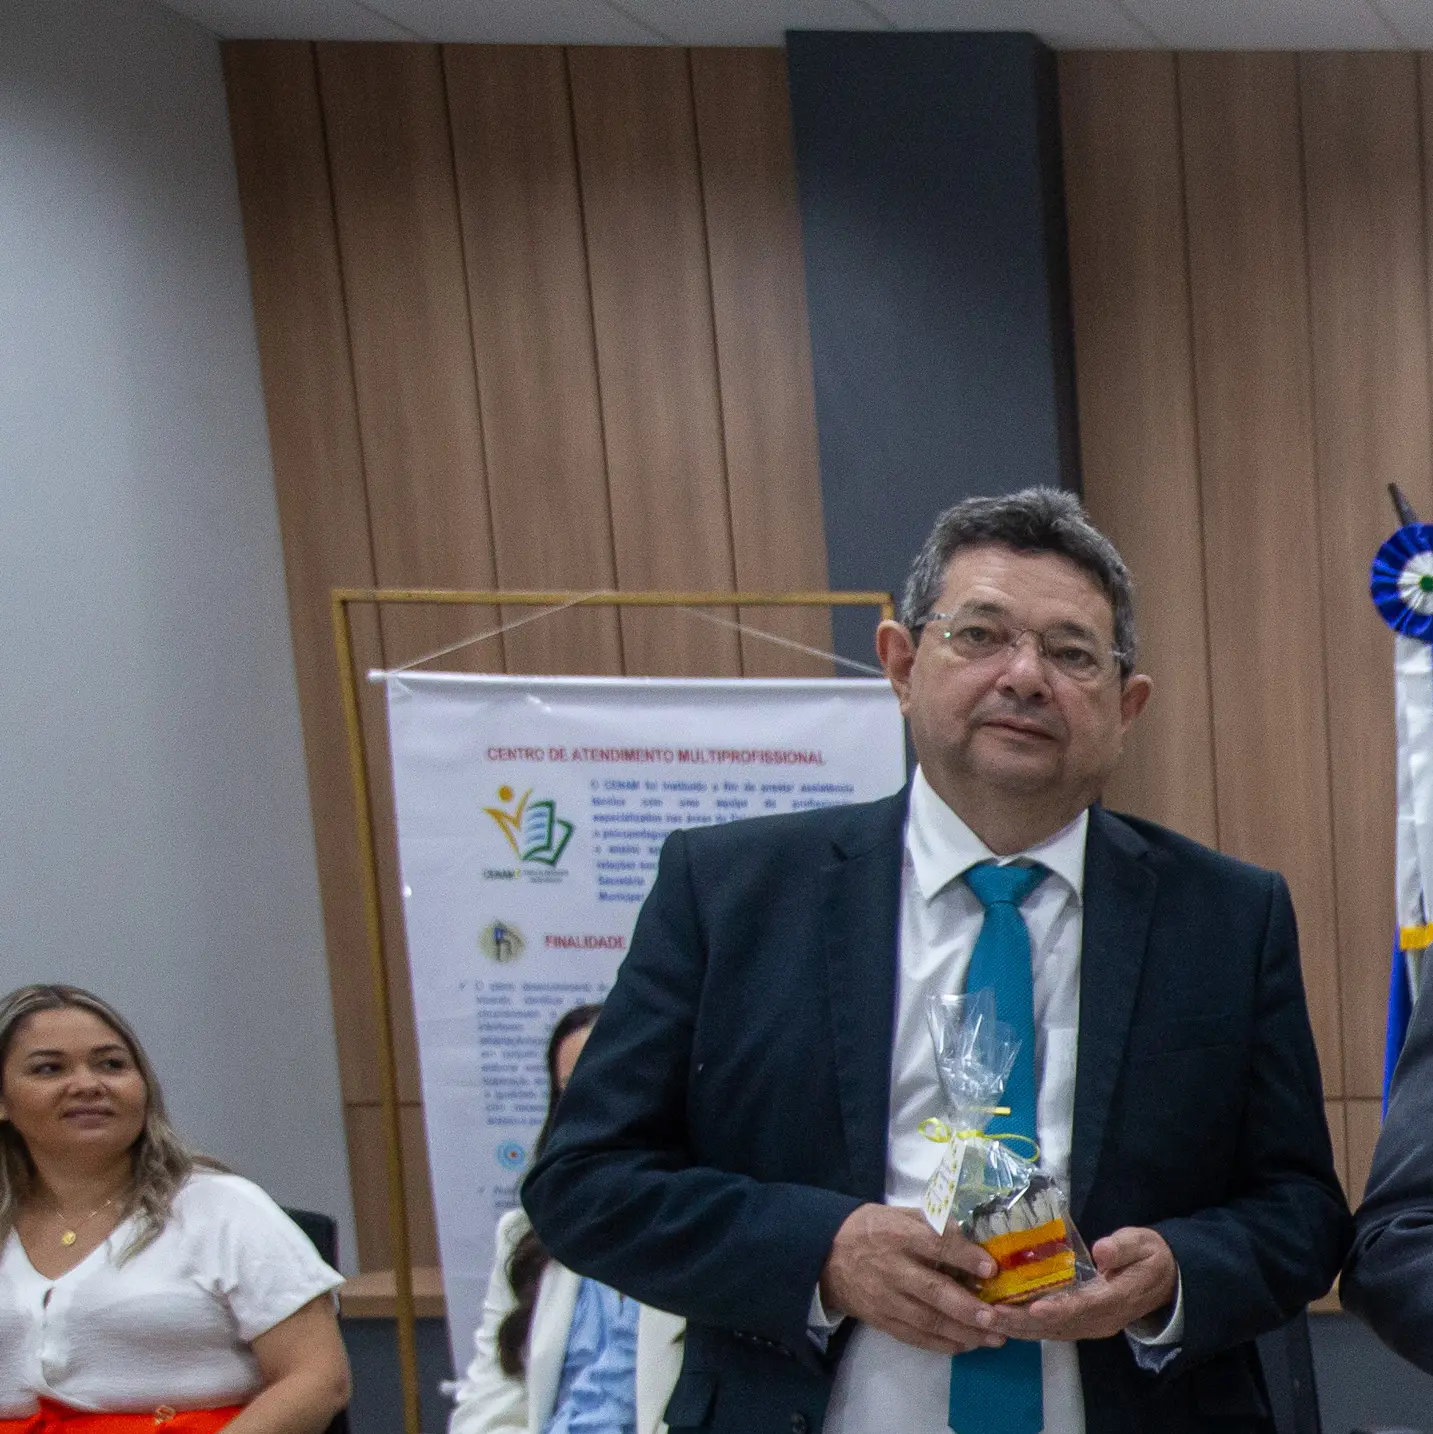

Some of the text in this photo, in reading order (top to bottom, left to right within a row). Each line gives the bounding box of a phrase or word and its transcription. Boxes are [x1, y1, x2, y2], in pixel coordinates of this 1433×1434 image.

[487, 748, 825, 765] CENTRO DE ATENDIMENTO MULTIPROFISSIONAL
[545, 935, 626, 950] FINALIDADE
